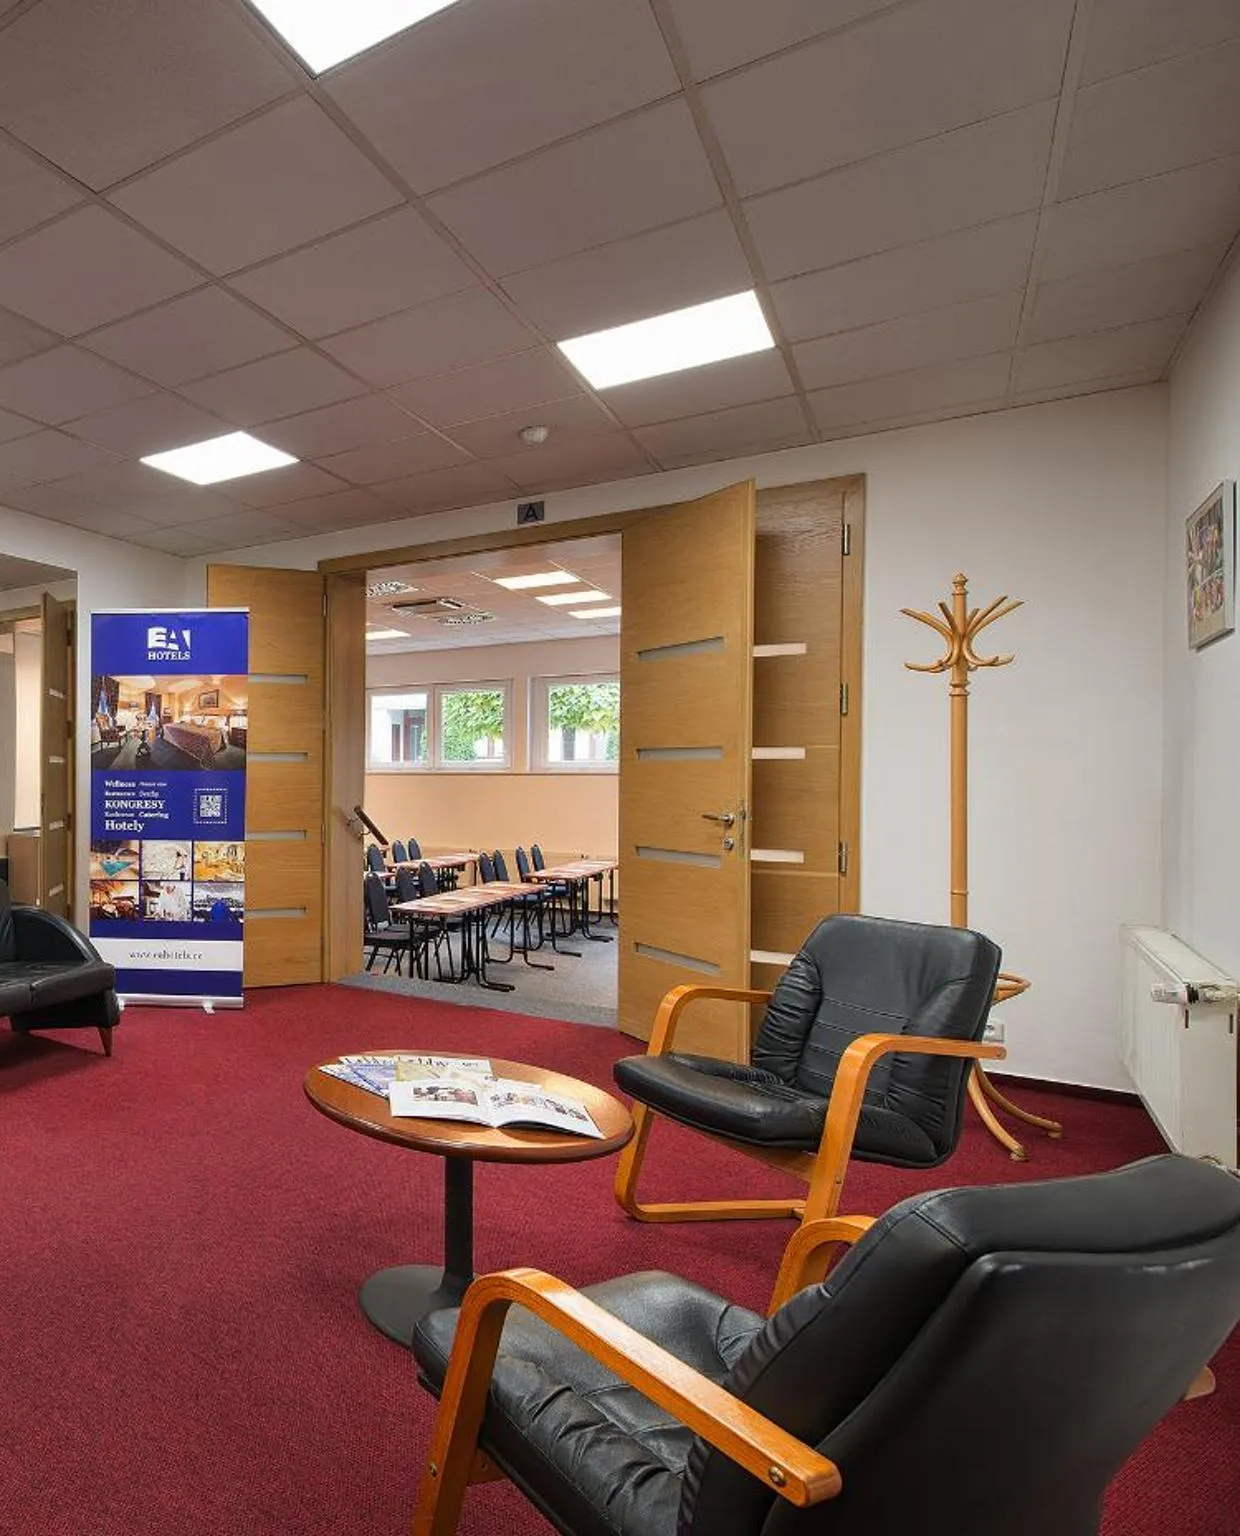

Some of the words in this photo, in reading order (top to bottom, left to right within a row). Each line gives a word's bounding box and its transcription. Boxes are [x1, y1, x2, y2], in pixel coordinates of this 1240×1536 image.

[524, 503, 538, 521] A
[148, 651, 191, 660] HOTELS
[105, 800, 165, 809] KONGRESY
[105, 819, 145, 832] Hotely
